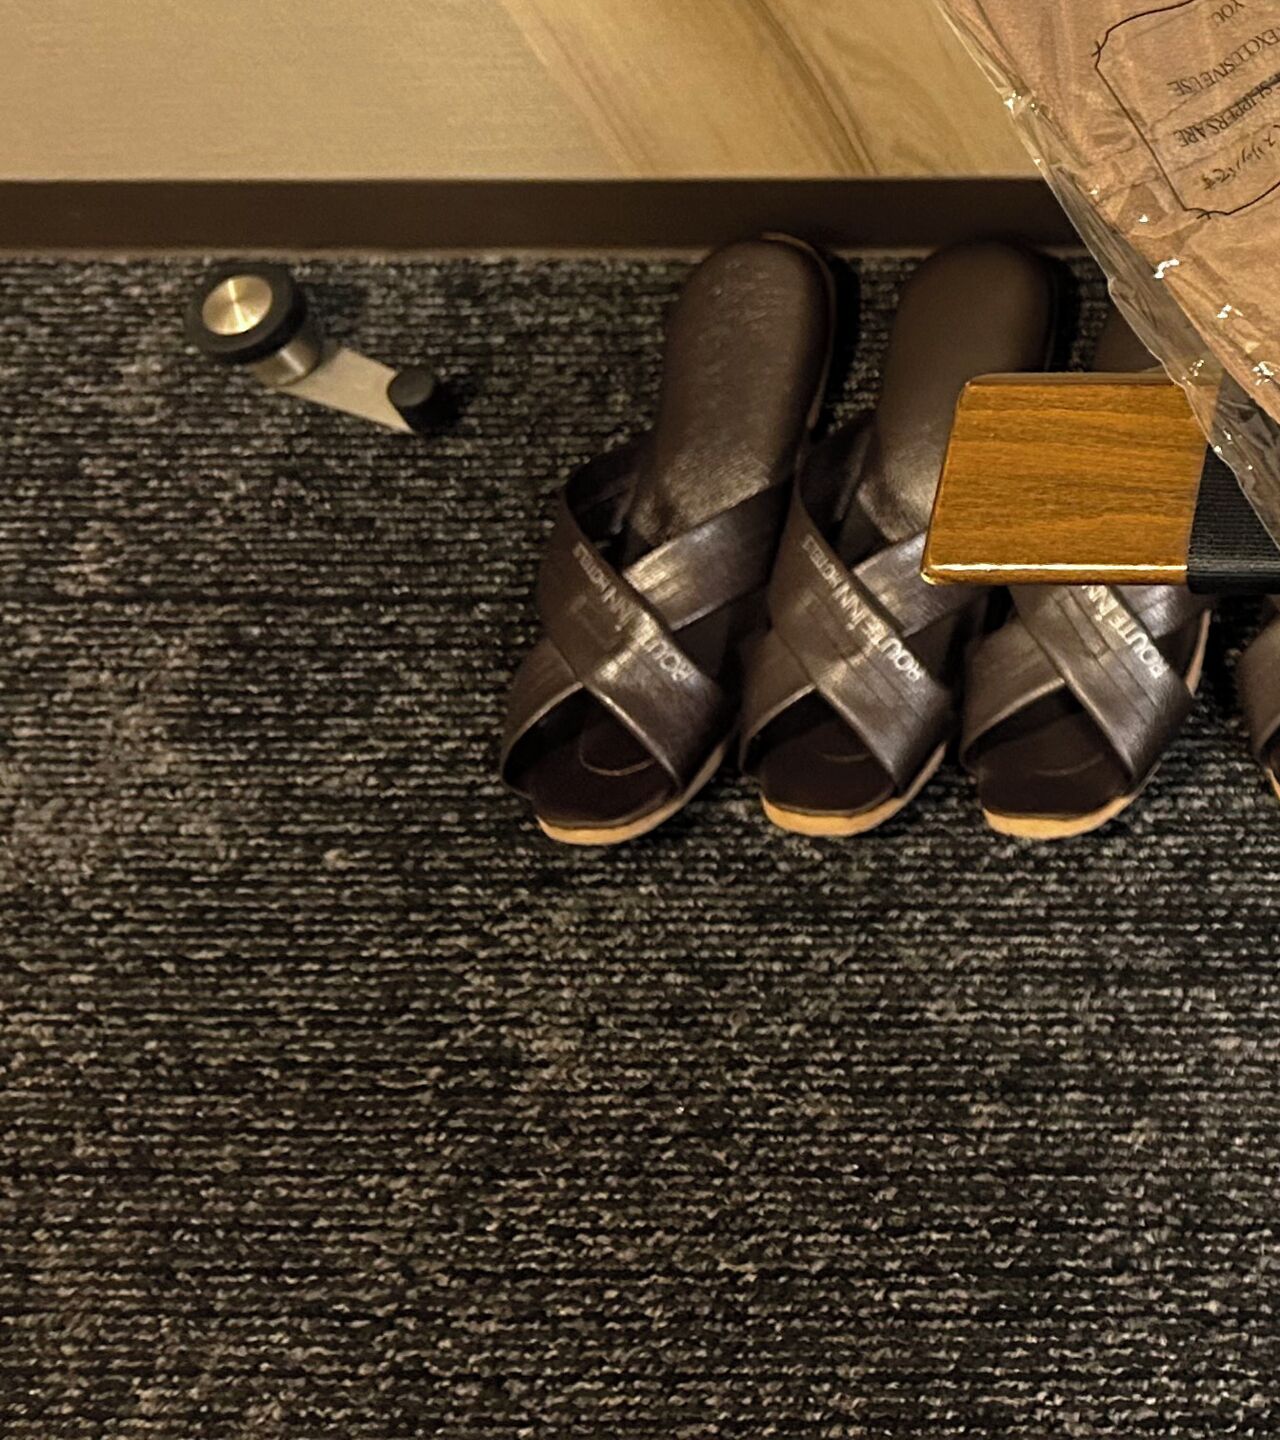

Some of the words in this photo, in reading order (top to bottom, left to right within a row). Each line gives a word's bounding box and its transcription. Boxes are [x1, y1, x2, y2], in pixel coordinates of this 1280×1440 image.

[1205, 28, 1280, 88] EXCLUSIVE
[1167, 73, 1205, 96] USE
[1173, 124, 1212, 148] ARE
[1108, 616, 1170, 679] ROUTE
